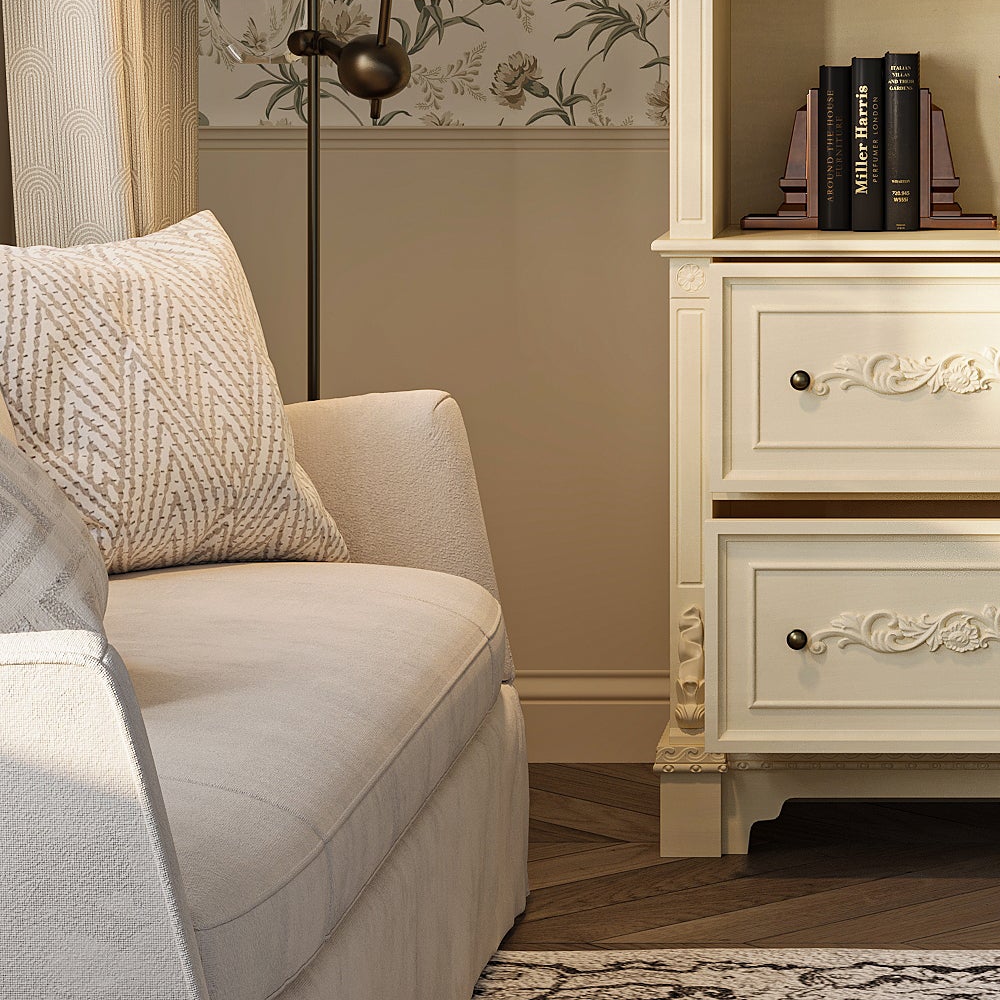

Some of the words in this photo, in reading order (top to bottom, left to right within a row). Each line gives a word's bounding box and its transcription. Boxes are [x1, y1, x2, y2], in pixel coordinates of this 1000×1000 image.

[826, 90, 834, 126] HOUSE
[855, 85, 869, 139] Harris
[826, 132, 834, 151] THE
[826, 156, 834, 202] AROUND
[855, 143, 869, 195] Miller
